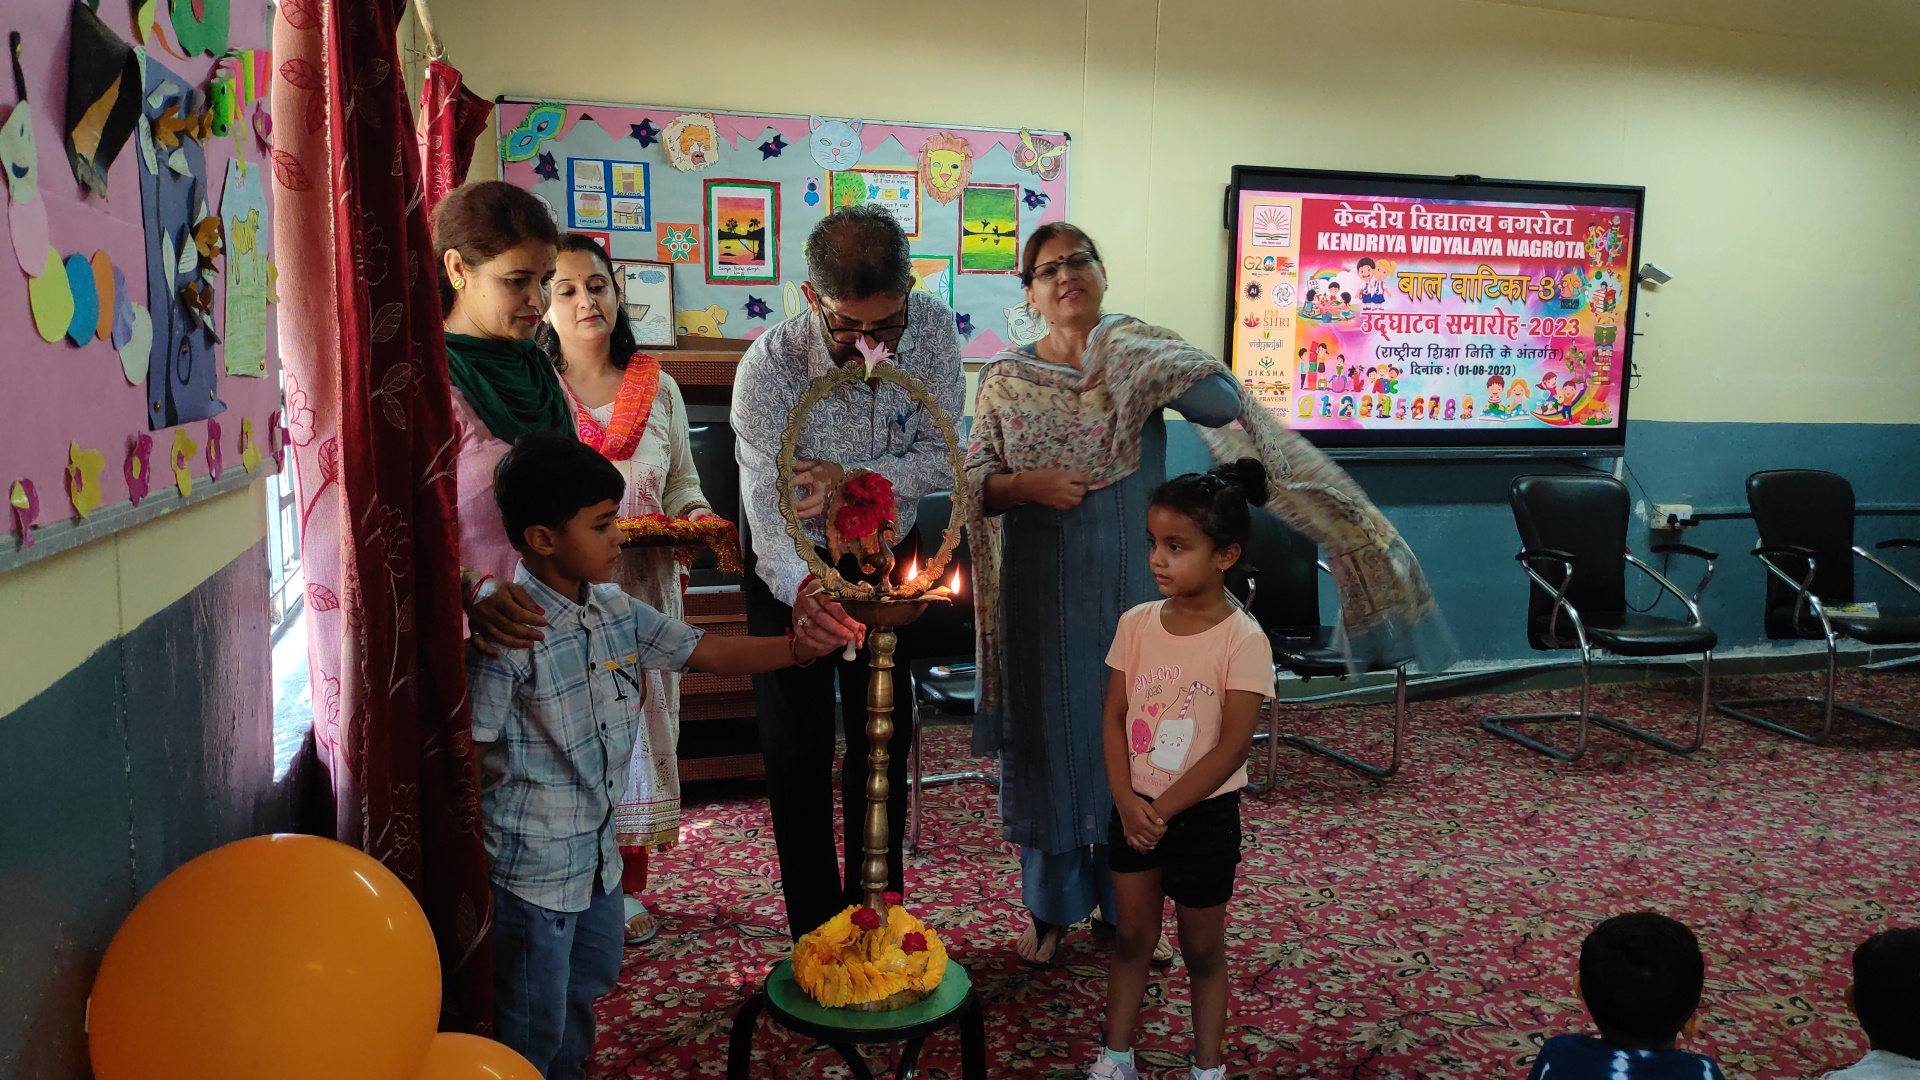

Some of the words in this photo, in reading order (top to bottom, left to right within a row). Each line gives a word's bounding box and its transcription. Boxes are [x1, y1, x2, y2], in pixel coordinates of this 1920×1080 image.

[1333, 202, 1405, 229] केन्द्रीय
[1409, 204, 1494, 233] विद्यालय
[1498, 211, 1575, 236] नगरोटा
[1317, 232, 1407, 253] KENDRIYA
[1410, 235, 1503, 256] VIDYALAYA
[1506, 239, 1586, 259] NAGROTA
[1397, 271, 1447, 302] बाल
[1451, 264, 1556, 303] वाटिका-3
[1264, 309, 1279, 318] PM
[1263, 318, 1290, 327] SHRI
[1446, 307, 1580, 341] समारोह-2023
[1427, 345, 1461, 359] शिक्षा
[1465, 345, 1495, 359] निति
[1500, 345, 1512, 359] के
[1454, 363, 1517, 377] (01-08-2023)
[1372, 378, 1399, 394] ABC
